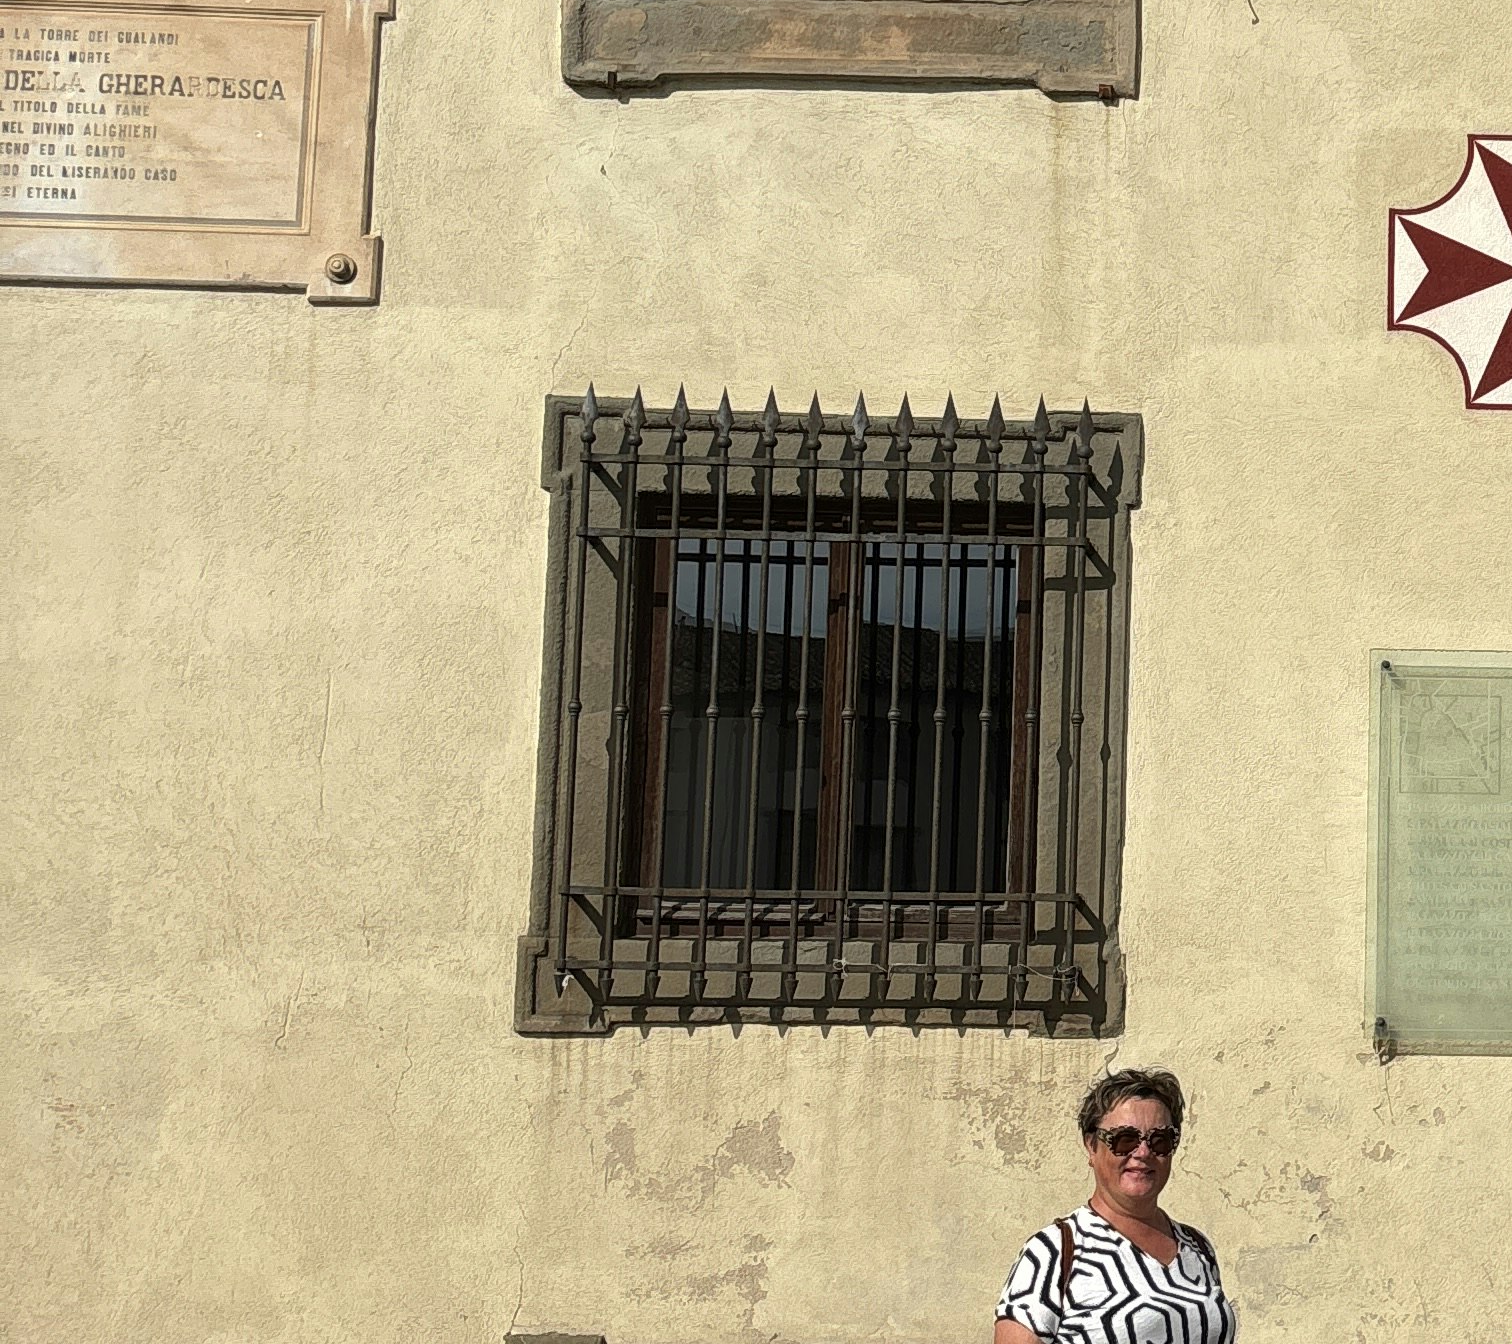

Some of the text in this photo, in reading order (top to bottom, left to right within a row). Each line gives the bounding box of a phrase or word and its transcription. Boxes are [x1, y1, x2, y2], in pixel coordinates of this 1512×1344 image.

[15, 28, 30, 40] LA
[40, 28, 80, 42] TORRE
[88, 30, 109, 43] DEI
[117, 31, 179, 46] GUALANDI
[9, 48, 111, 64] TRAGICA MORTE
[4, 69, 86, 94] DELLA
[13, 100, 58, 113] TITOLO
[67, 102, 107, 115] DELLA
[116, 103, 151, 117] FAME
[2, 121, 158, 139] NEL DIVINO ALIGHIERI
[39, 144, 56, 156] ED
[65, 144, 78, 156] IL
[85, 145, 126, 159] CANTO
[30, 164, 54, 177] DEL
[144, 167, 178, 182] CASO
[26, 187, 78, 200] ETERNA
